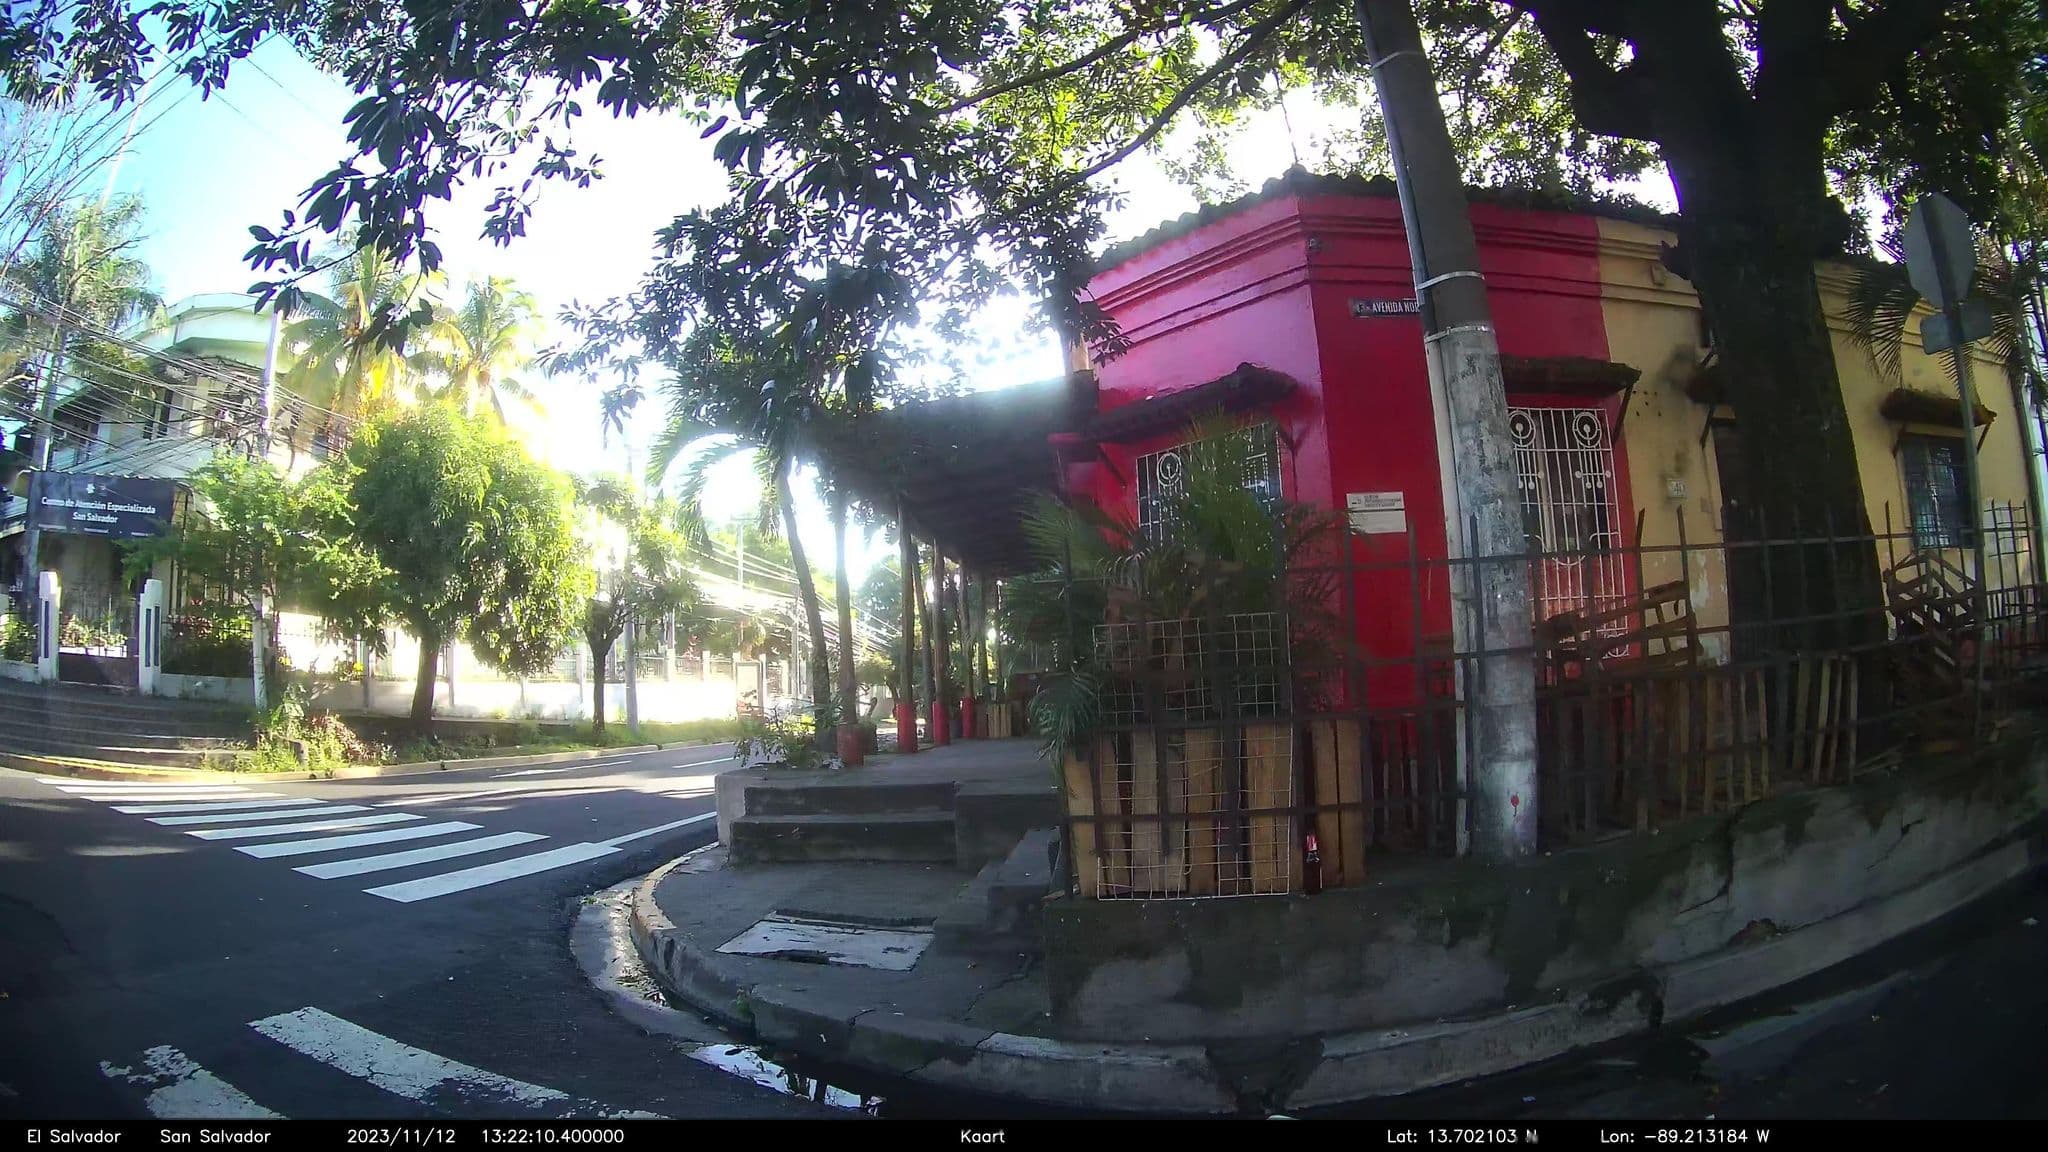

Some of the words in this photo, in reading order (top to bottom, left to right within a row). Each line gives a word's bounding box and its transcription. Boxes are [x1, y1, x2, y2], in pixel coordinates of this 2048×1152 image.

[1372, 301, 1404, 313] AVENIDA
[65, 498, 75, 507] de
[107, 502, 156, 514] Especializada
[73, 511, 86, 521] San
[86, 512, 118, 523] Salvador
